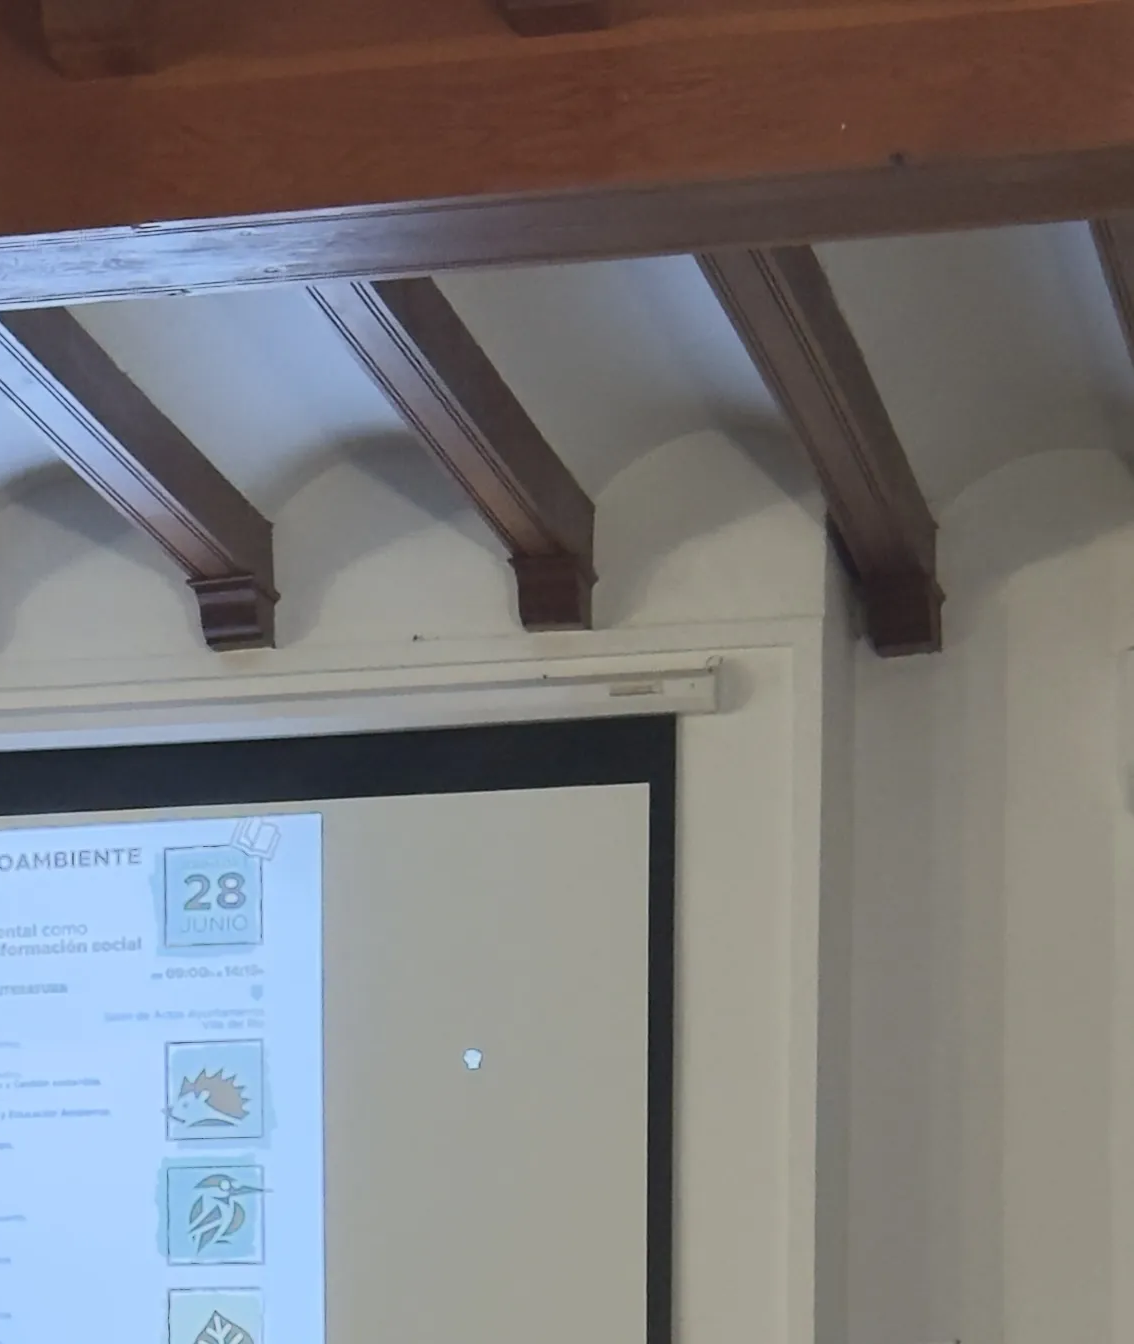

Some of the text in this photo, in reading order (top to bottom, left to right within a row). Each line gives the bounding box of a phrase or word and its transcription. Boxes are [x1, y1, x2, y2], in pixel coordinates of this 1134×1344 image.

[182, 872, 248, 911] 28
[41, 923, 89, 938] como
[180, 914, 248, 933] JUNIO
[91, 935, 143, 953] social
